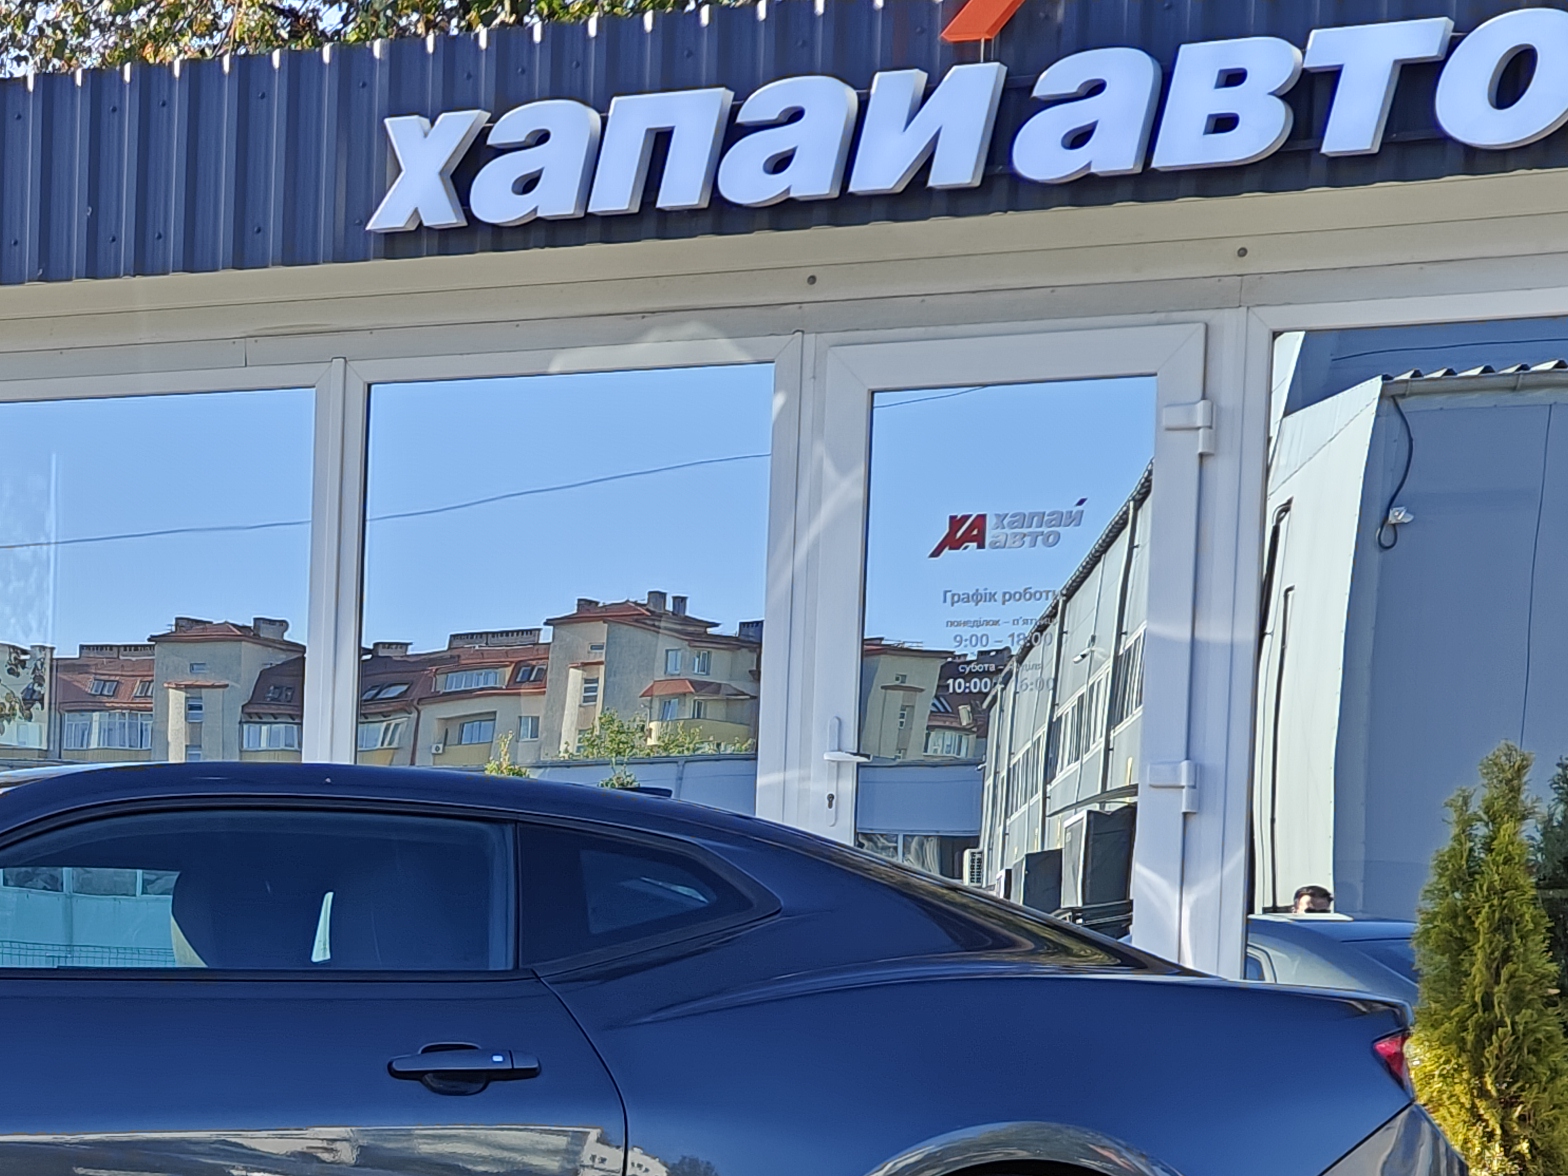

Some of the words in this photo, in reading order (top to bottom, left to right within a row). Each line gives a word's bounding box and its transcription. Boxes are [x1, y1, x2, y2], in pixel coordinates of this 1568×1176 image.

[367, 0, 1028, 232] хапай
[1010, 6, 1568, 185] авто
[990, 497, 1088, 531] хапай
[988, 529, 1062, 550] авто
[942, 587, 998, 607] Графік
[953, 633, 990, 648] 9:00
[1007, 631, 1053, 647] 18:00
[958, 661, 996, 674] субота
[946, 678, 991, 693] 10:00
[1019, 677, 1054, 692] 6:00
